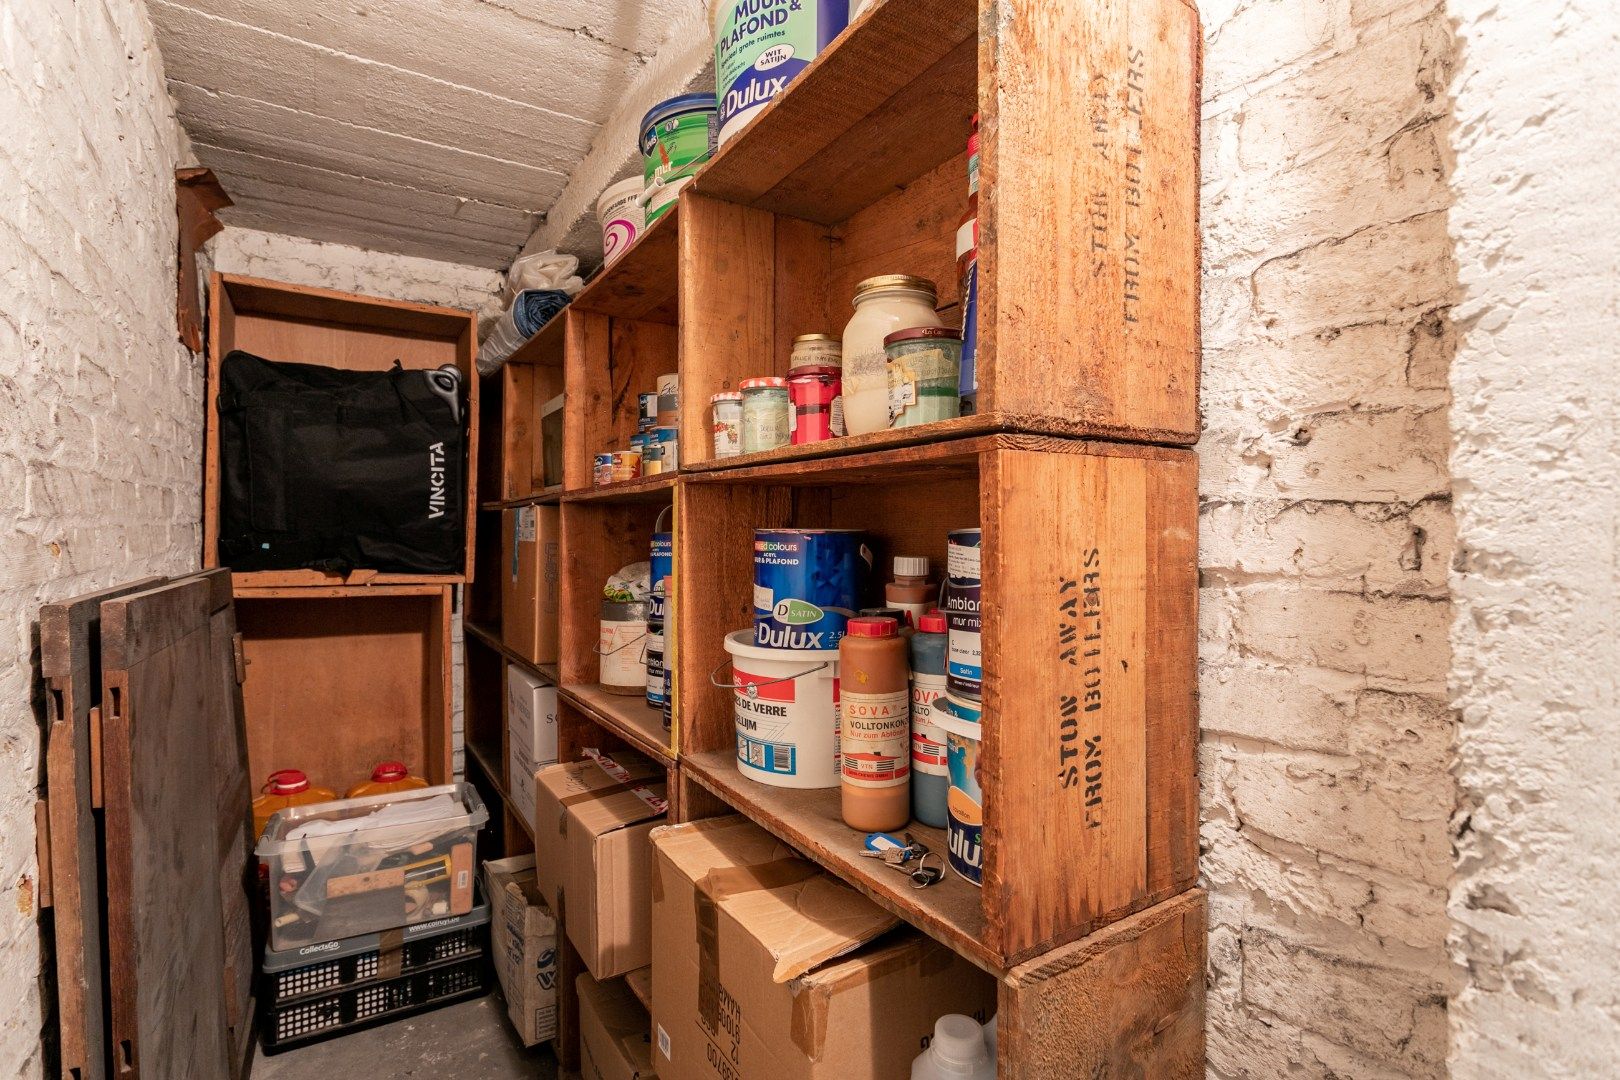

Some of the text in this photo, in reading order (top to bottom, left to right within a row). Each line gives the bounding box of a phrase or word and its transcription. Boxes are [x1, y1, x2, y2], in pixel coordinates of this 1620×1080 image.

[720, 8, 789, 58] PLAFOND
[757, 30, 786, 42] ruimtes
[760, 54, 787, 66] SATIJN
[765, 48, 782, 58] WIT
[726, 75, 788, 118] Dulux
[1124, 232, 1140, 324] FROM
[428, 441, 445, 519] VINCITA
[768, 542, 798, 552] colours
[778, 604, 817, 618] D SATIN
[952, 617, 966, 626] mur
[1059, 577, 1078, 665] AWAY
[758, 622, 824, 649] Dulux
[1083, 548, 1101, 713] BOILERS
[960, 667, 973, 675] Satin
[742, 699, 752, 711] DE
[753, 702, 788, 717] VERRE
[849, 704, 890, 716] SOVA
[850, 730, 862, 738] Nur
[1058, 695, 1078, 789] STOW
[1084, 735, 1102, 829] FROM
[949, 827, 982, 870] ulu
